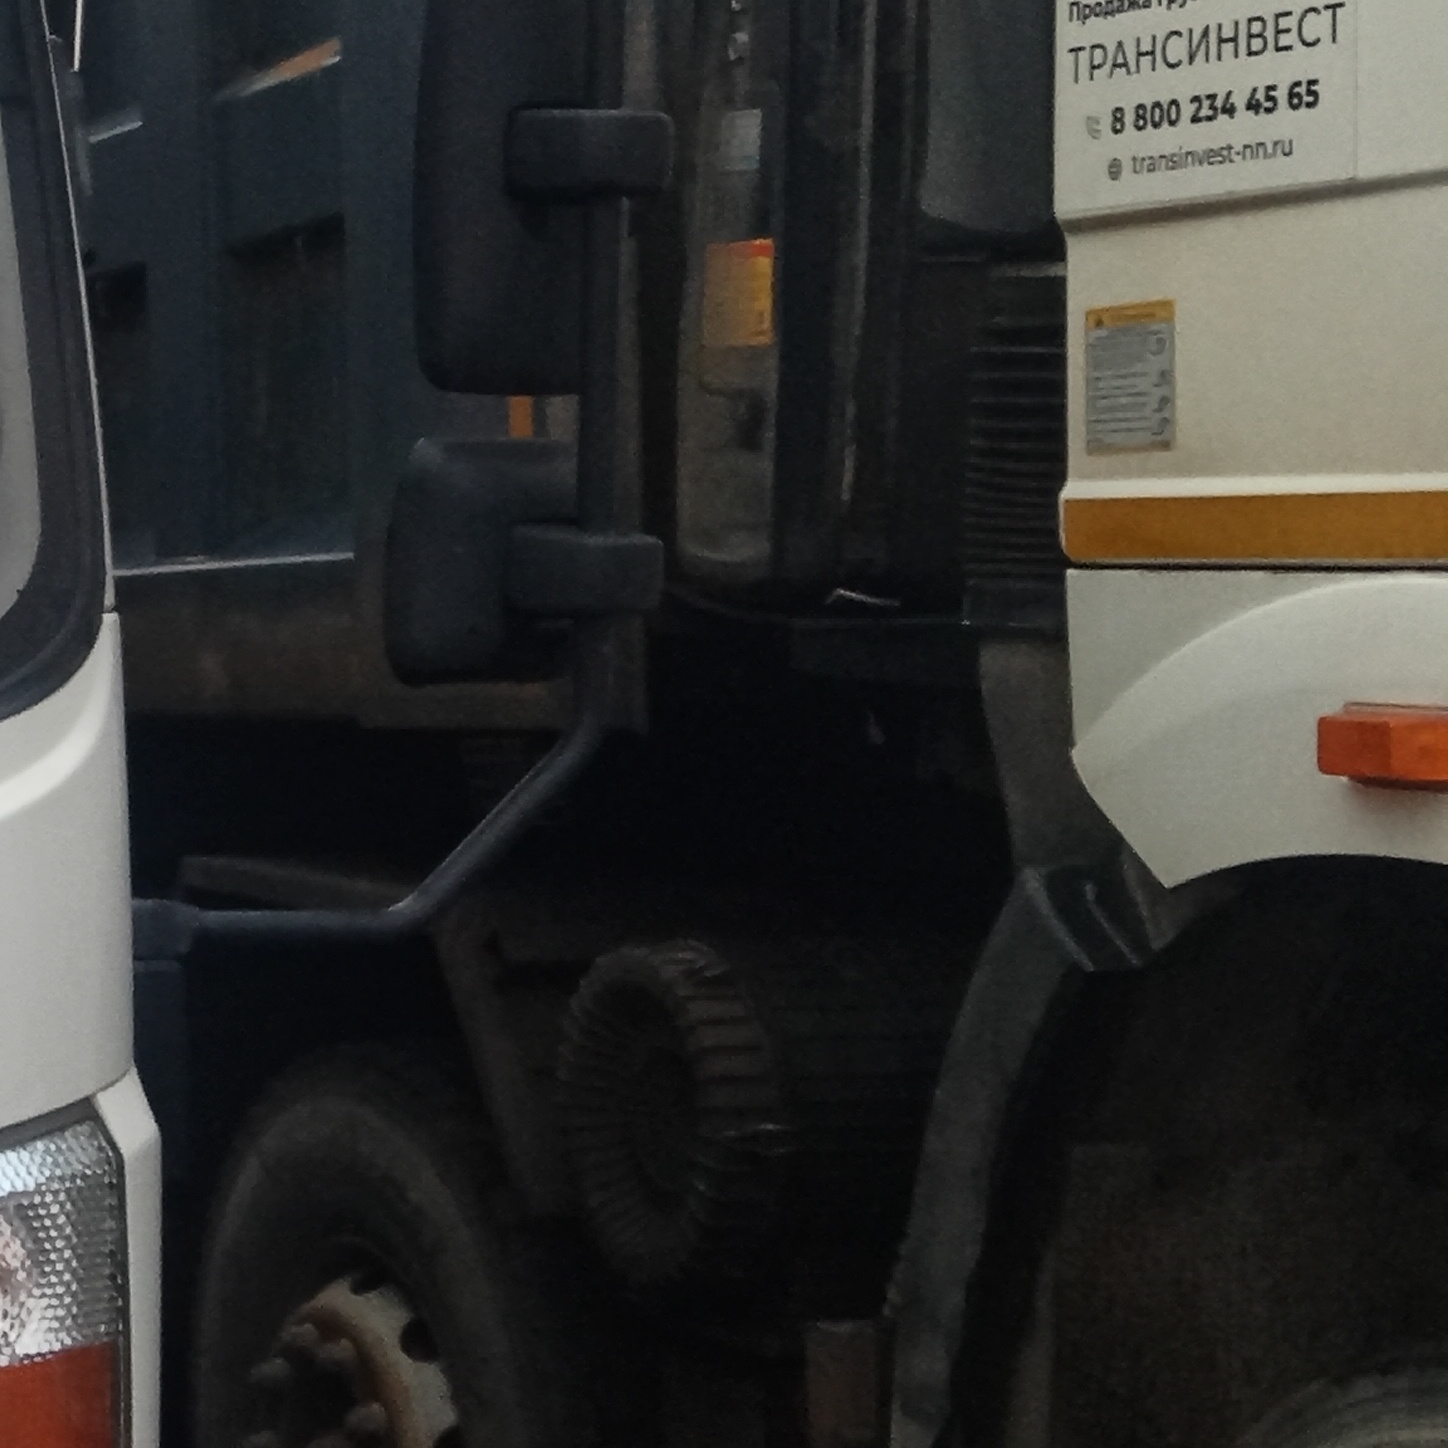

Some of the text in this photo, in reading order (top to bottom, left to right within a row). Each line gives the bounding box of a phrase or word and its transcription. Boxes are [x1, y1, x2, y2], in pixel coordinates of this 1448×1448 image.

[1067, 2, 1346, 85] ТРАНСИНВЕСТ
[1110, 79, 1320, 135] 8 800 234 45 65
[1131, 138, 1294, 175] transinvest-nn.ru
